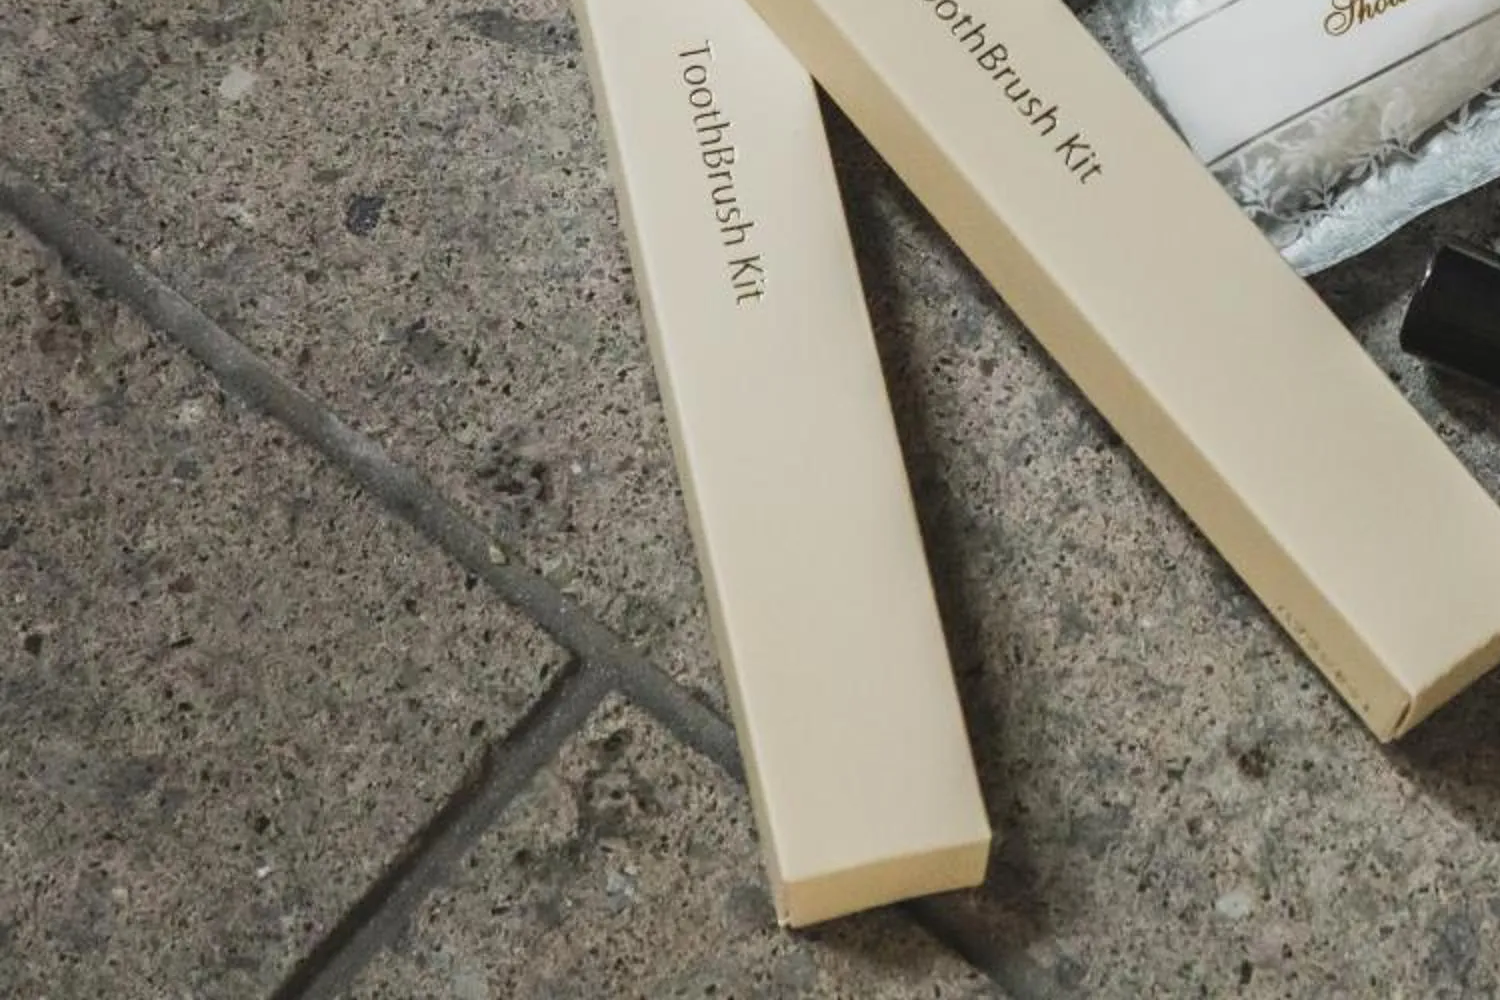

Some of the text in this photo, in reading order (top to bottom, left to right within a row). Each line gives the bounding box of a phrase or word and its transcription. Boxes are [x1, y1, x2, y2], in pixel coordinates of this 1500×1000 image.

[678, 39, 767, 307] ToothBrush Kit
[1054, 132, 1104, 186] Kit
